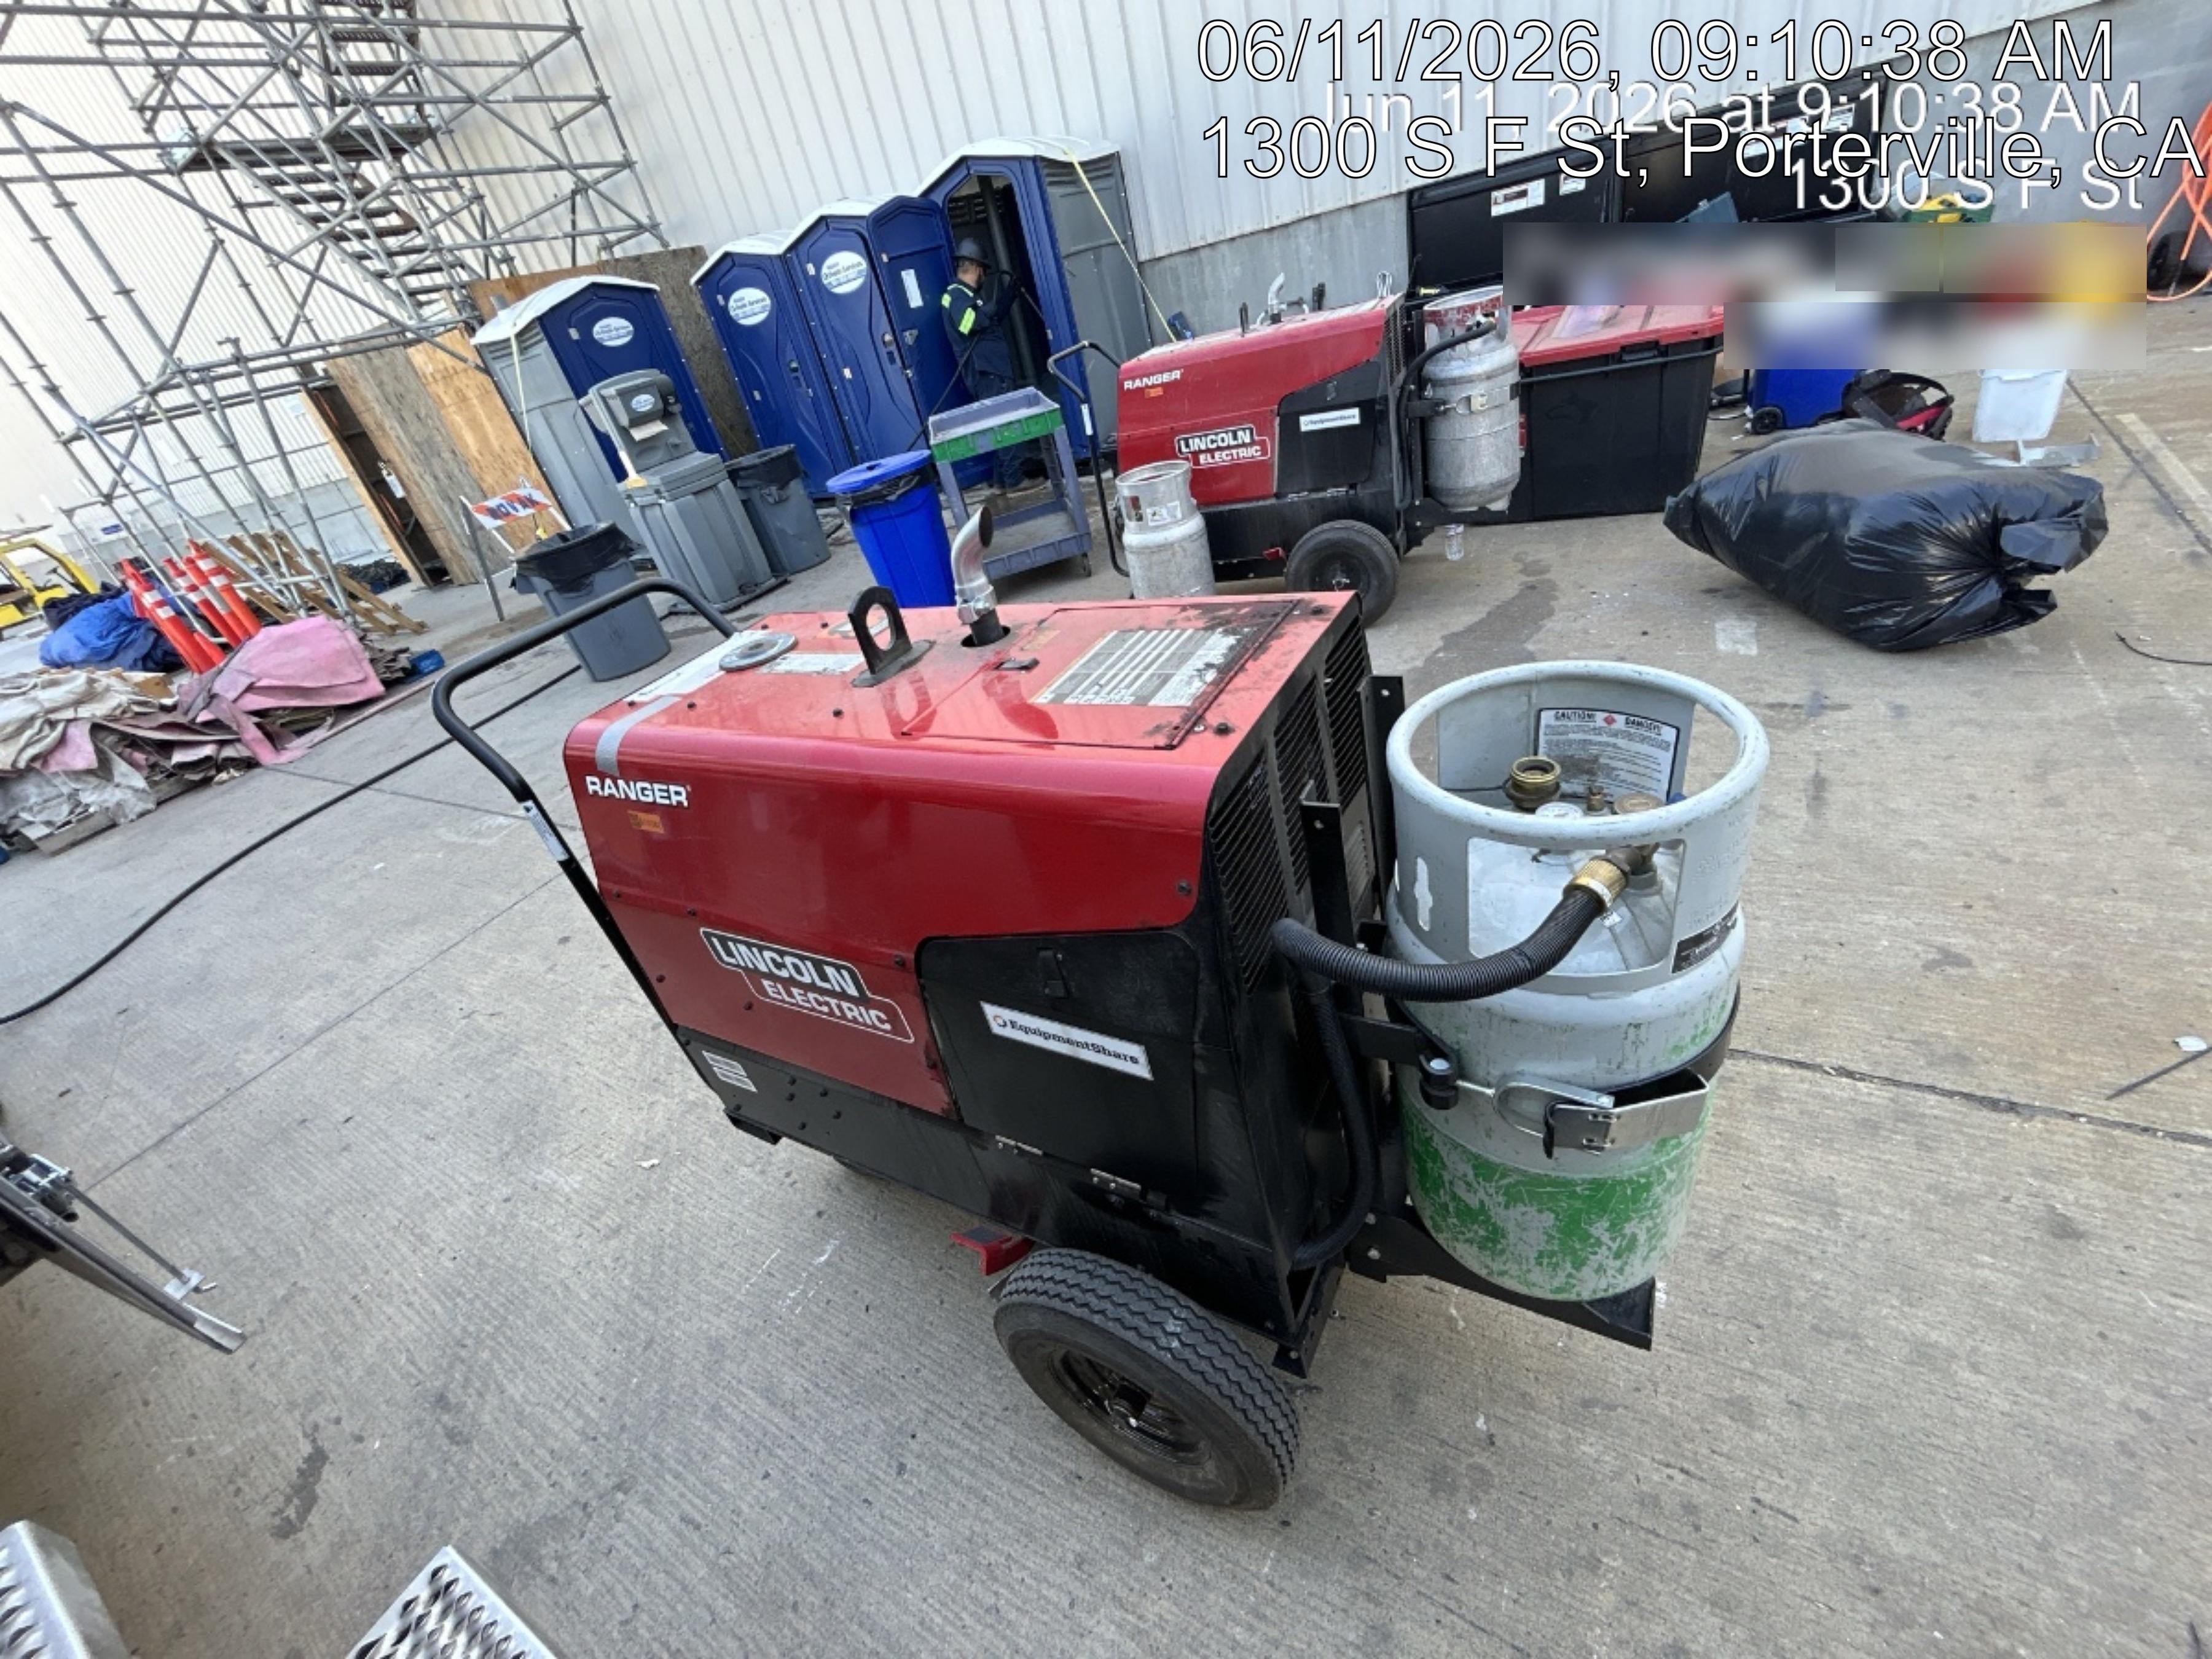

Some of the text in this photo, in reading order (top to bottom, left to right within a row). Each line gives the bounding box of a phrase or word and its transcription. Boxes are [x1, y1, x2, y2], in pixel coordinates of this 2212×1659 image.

[1123, 369, 1181, 391] RANGER
[1179, 429, 1252, 453] LINCOLN
[1199, 445, 1262, 465] ELECTRIC
[586, 775, 688, 807] RANGER
[712, 936, 860, 998] LINCOLN
[761, 978, 892, 1031] ELECTRIC
[1008, 1018, 1140, 1065] EquipmentShare
